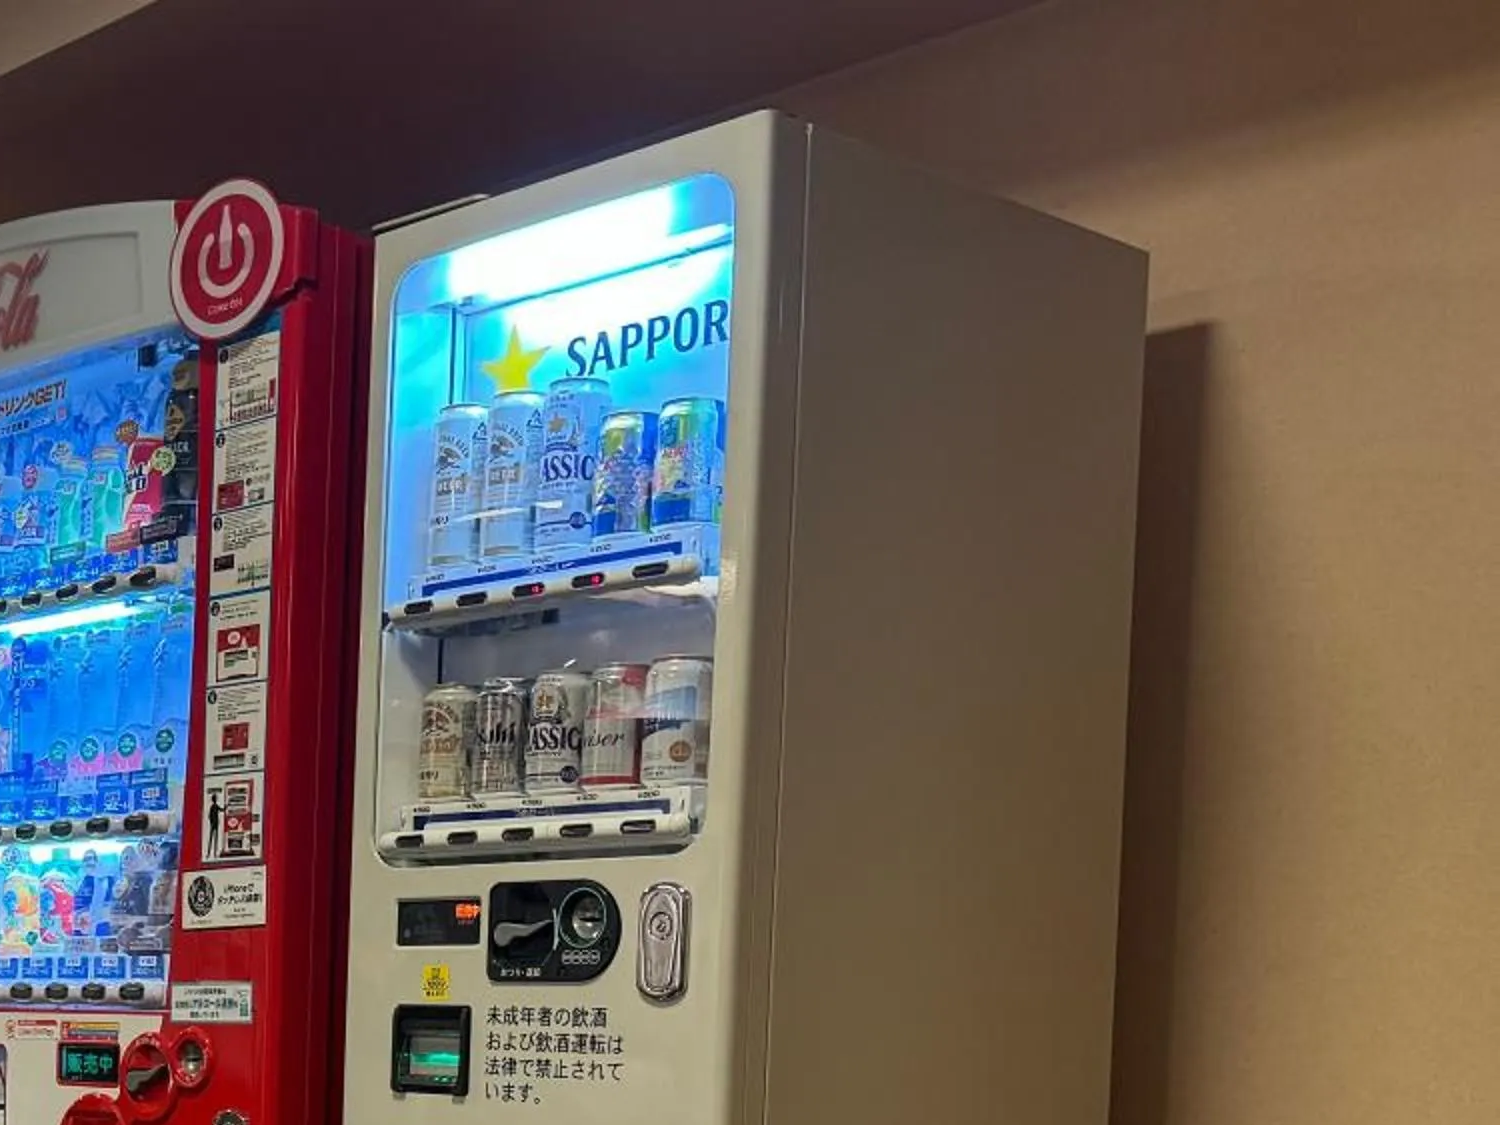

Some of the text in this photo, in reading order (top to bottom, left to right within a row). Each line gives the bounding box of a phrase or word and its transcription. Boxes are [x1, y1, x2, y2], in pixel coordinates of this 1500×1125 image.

[566, 300, 729, 378] SAPPOR
[529, 723, 582, 752] ASSIC
[487, 1005, 608, 1028] 未成年者の飲酒
[485, 1031, 624, 1055] および飲酒運転は
[67, 1053, 113, 1074] 販売中
[484, 1056, 625, 1081] 法律で禁止されて
[485, 1082, 541, 1105] います。
